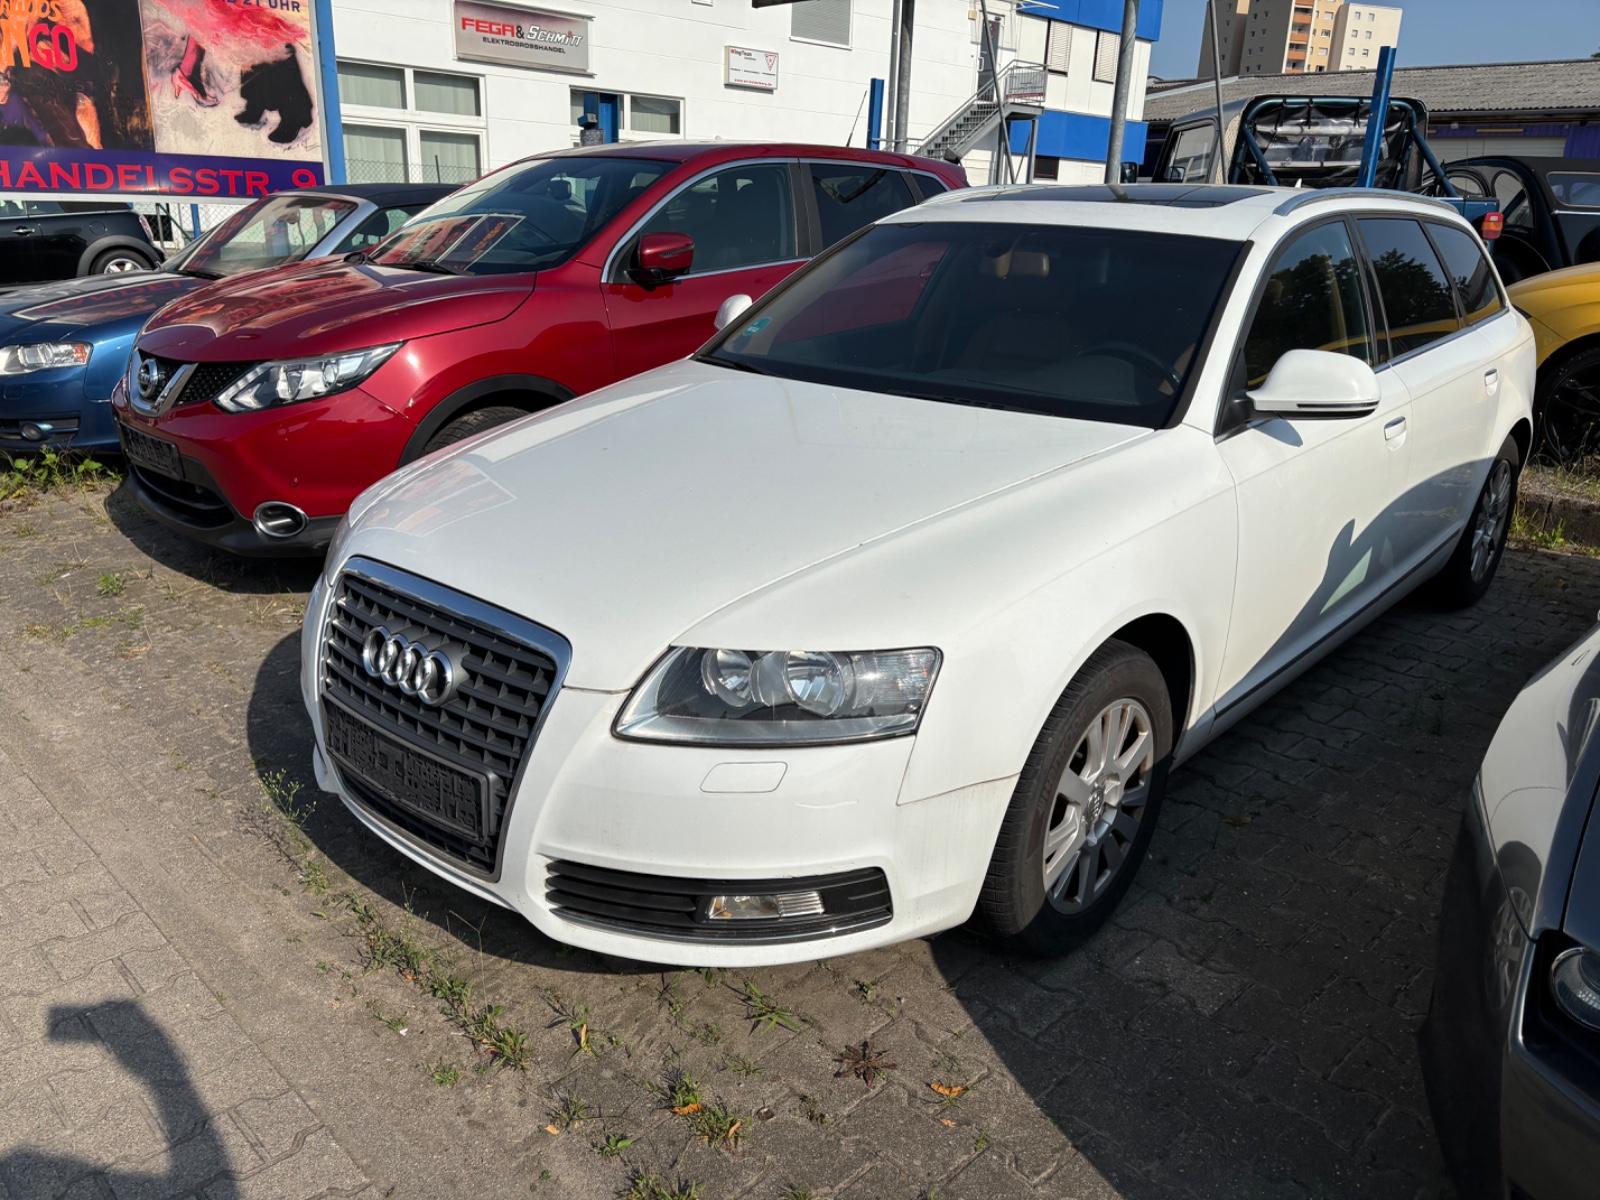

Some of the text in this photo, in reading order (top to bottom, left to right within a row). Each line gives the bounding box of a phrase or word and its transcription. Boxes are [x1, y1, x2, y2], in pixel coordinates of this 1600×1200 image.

[268, 0, 300, 12] UHR
[461, 17, 515, 38] FEGA
[515, 25, 525, 39] &
[482, 36, 566, 54] ELEKTROGROSSHANDEL
[292, 168, 316, 188] 9
